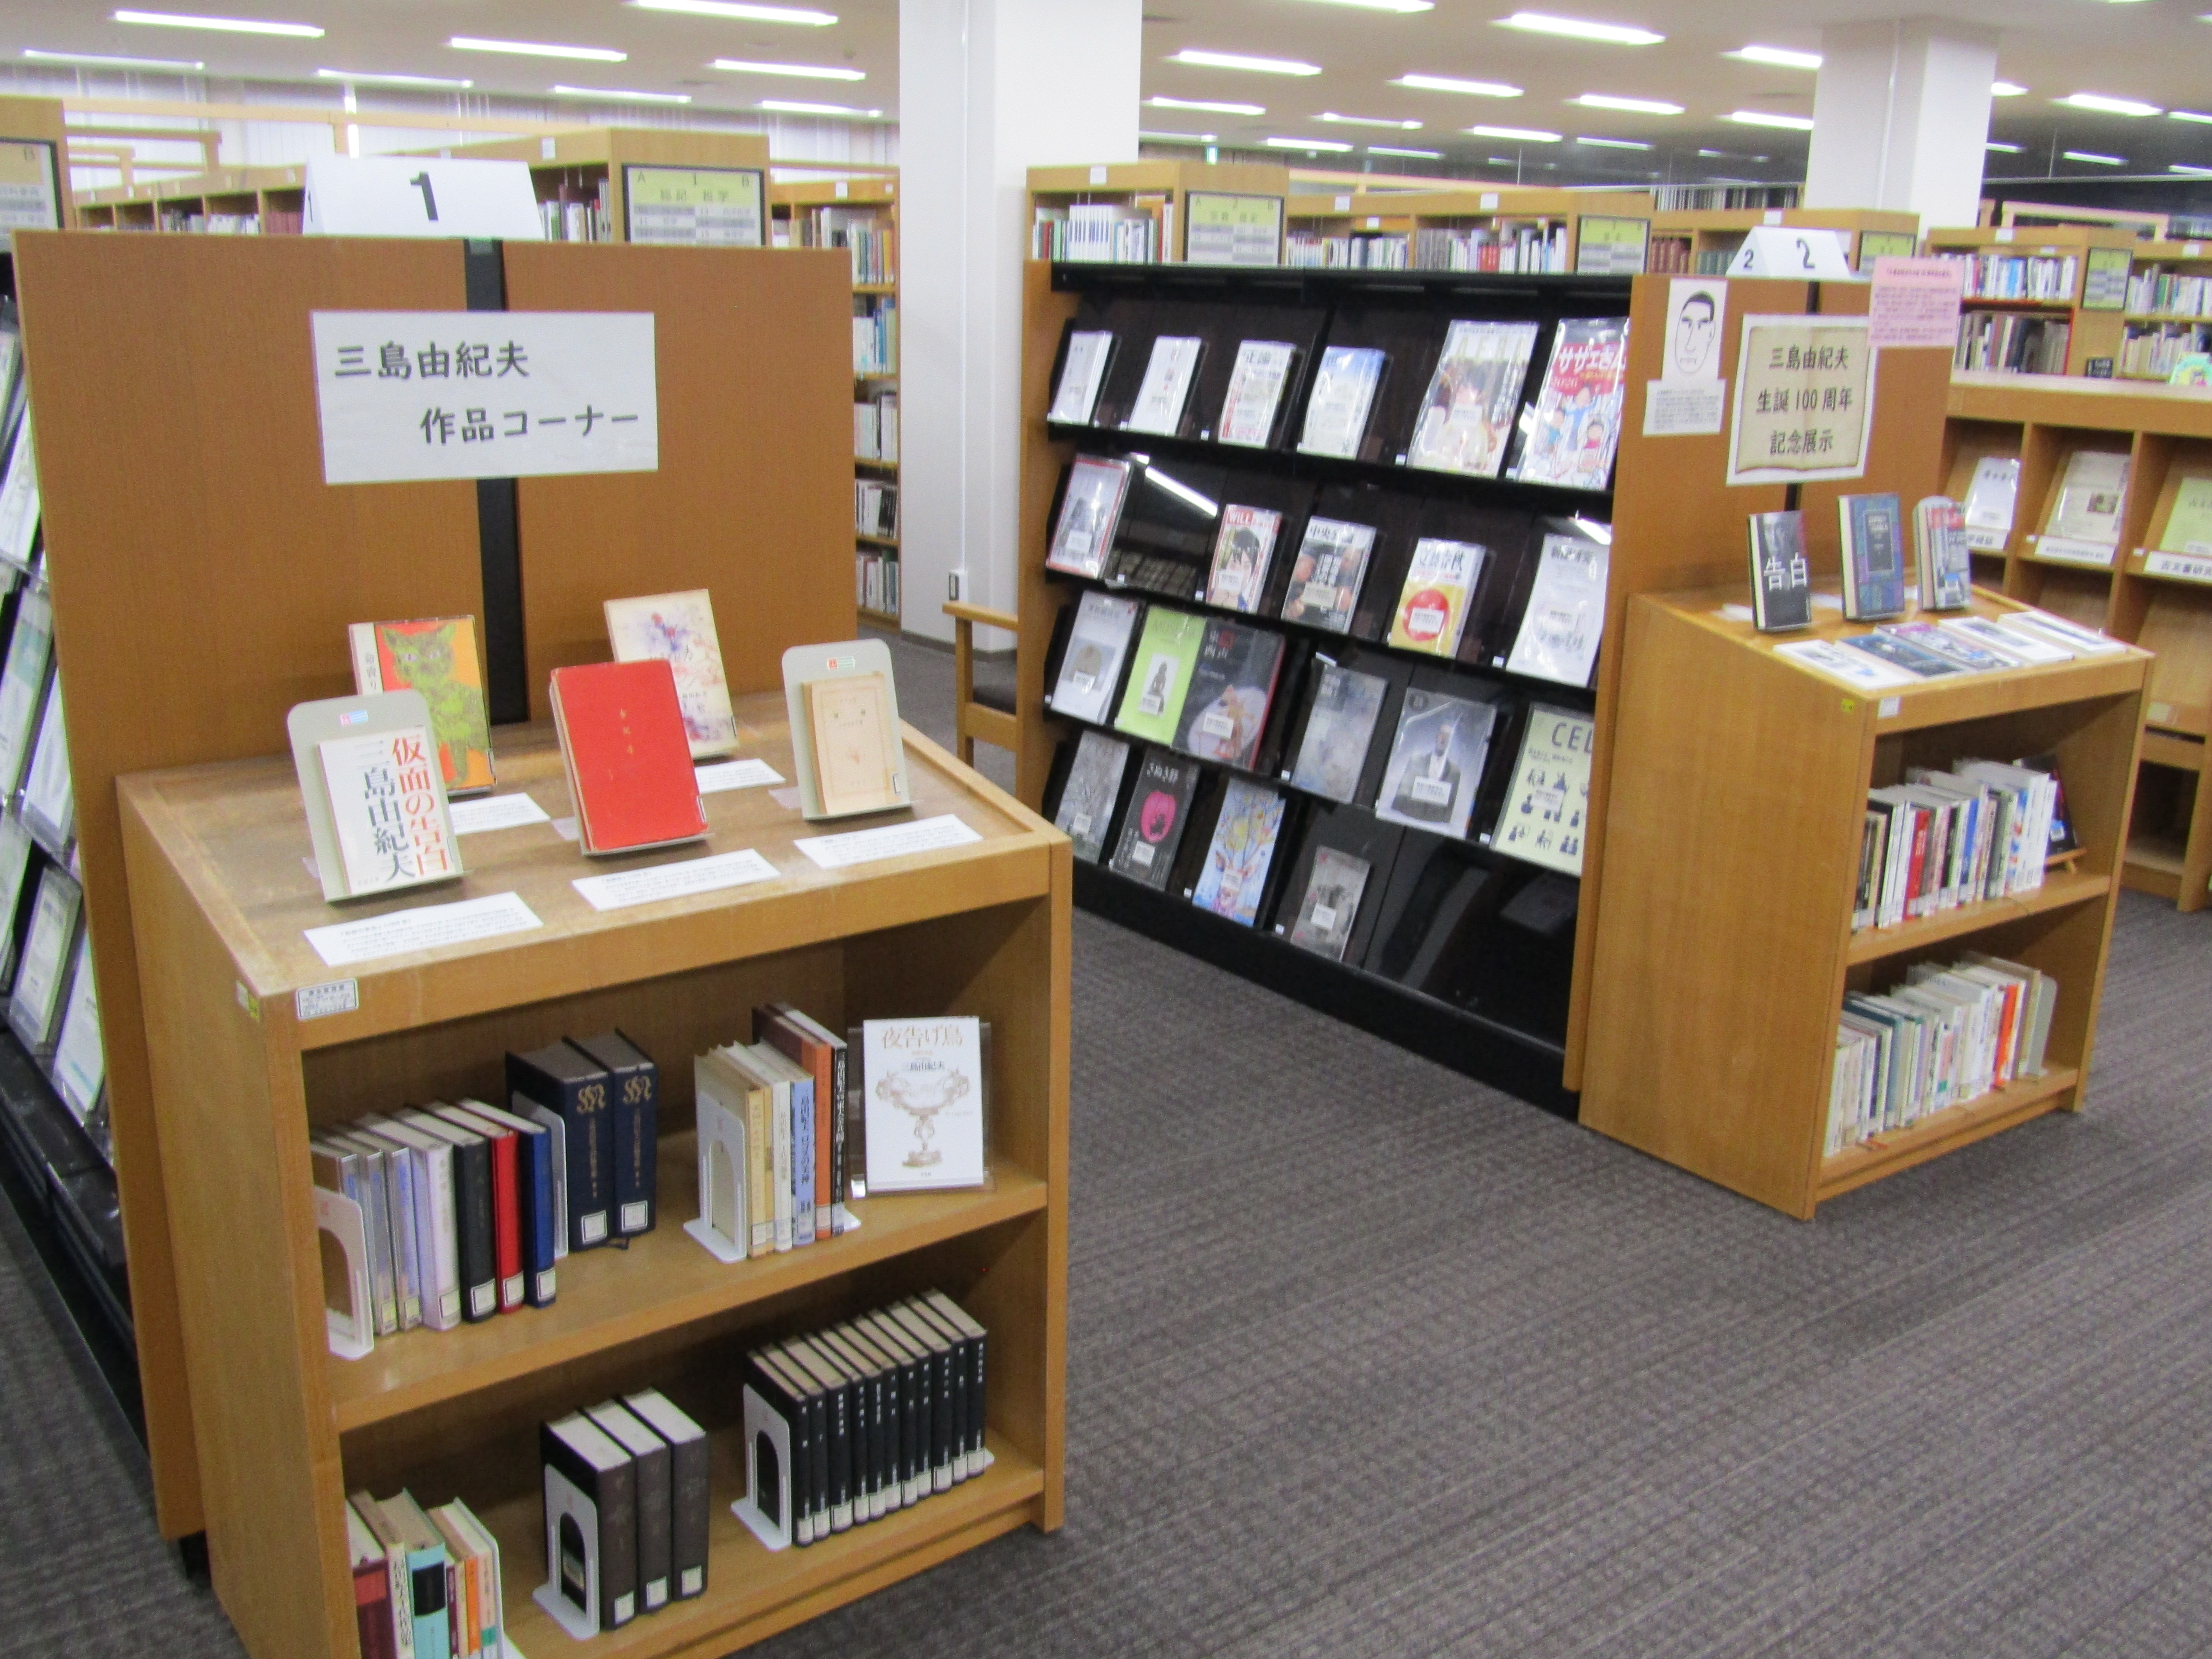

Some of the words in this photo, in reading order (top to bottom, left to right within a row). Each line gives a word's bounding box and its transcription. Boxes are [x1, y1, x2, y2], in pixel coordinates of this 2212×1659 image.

[409, 171, 439, 221] 1
[1744, 249, 1754, 269] 2
[1796, 238, 1815, 269] 2
[334, 340, 530, 380] 三島由紀夫
[1769, 344, 1849, 371] 三島由紀夫
[419, 404, 639, 444] 作品コーナー
[1769, 428, 1834, 456] 記念展示
[1763, 552, 1807, 591] 告白
[354, 740, 416, 881] 三島由紀夫
[392, 734, 448, 876] 仮面の告白
[882, 1024, 963, 1049] 夜告げ鳥
[902, 1060, 945, 1072] 三島由紀夫
